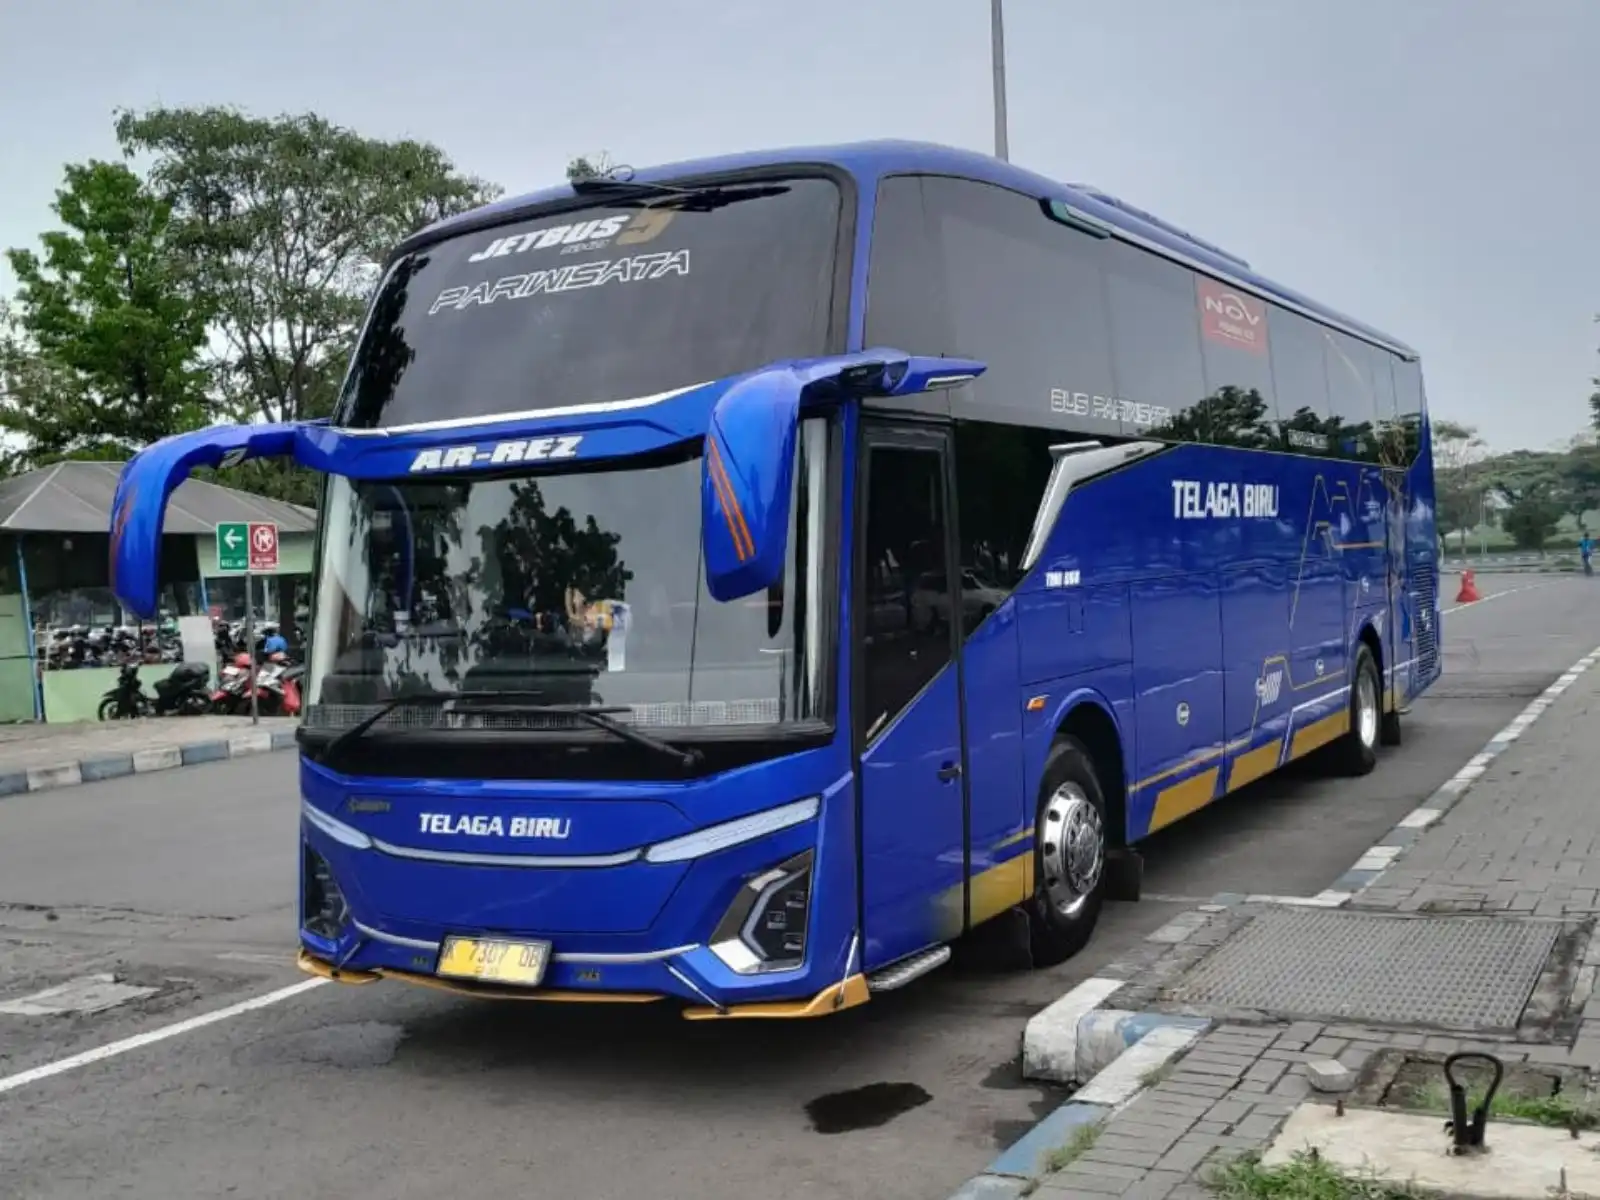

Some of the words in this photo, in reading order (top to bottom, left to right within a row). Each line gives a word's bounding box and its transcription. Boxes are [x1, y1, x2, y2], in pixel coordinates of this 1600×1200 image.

[468, 214, 630, 262] JETBUS
[428, 249, 690, 315] PARIWISATA
[409, 435, 584, 473] AR-REZ
[1172, 480, 1241, 519] TELAGA
[1242, 484, 1280, 518] BIRU
[419, 813, 504, 837] TELAGA
[509, 817, 571, 839] BIRU
